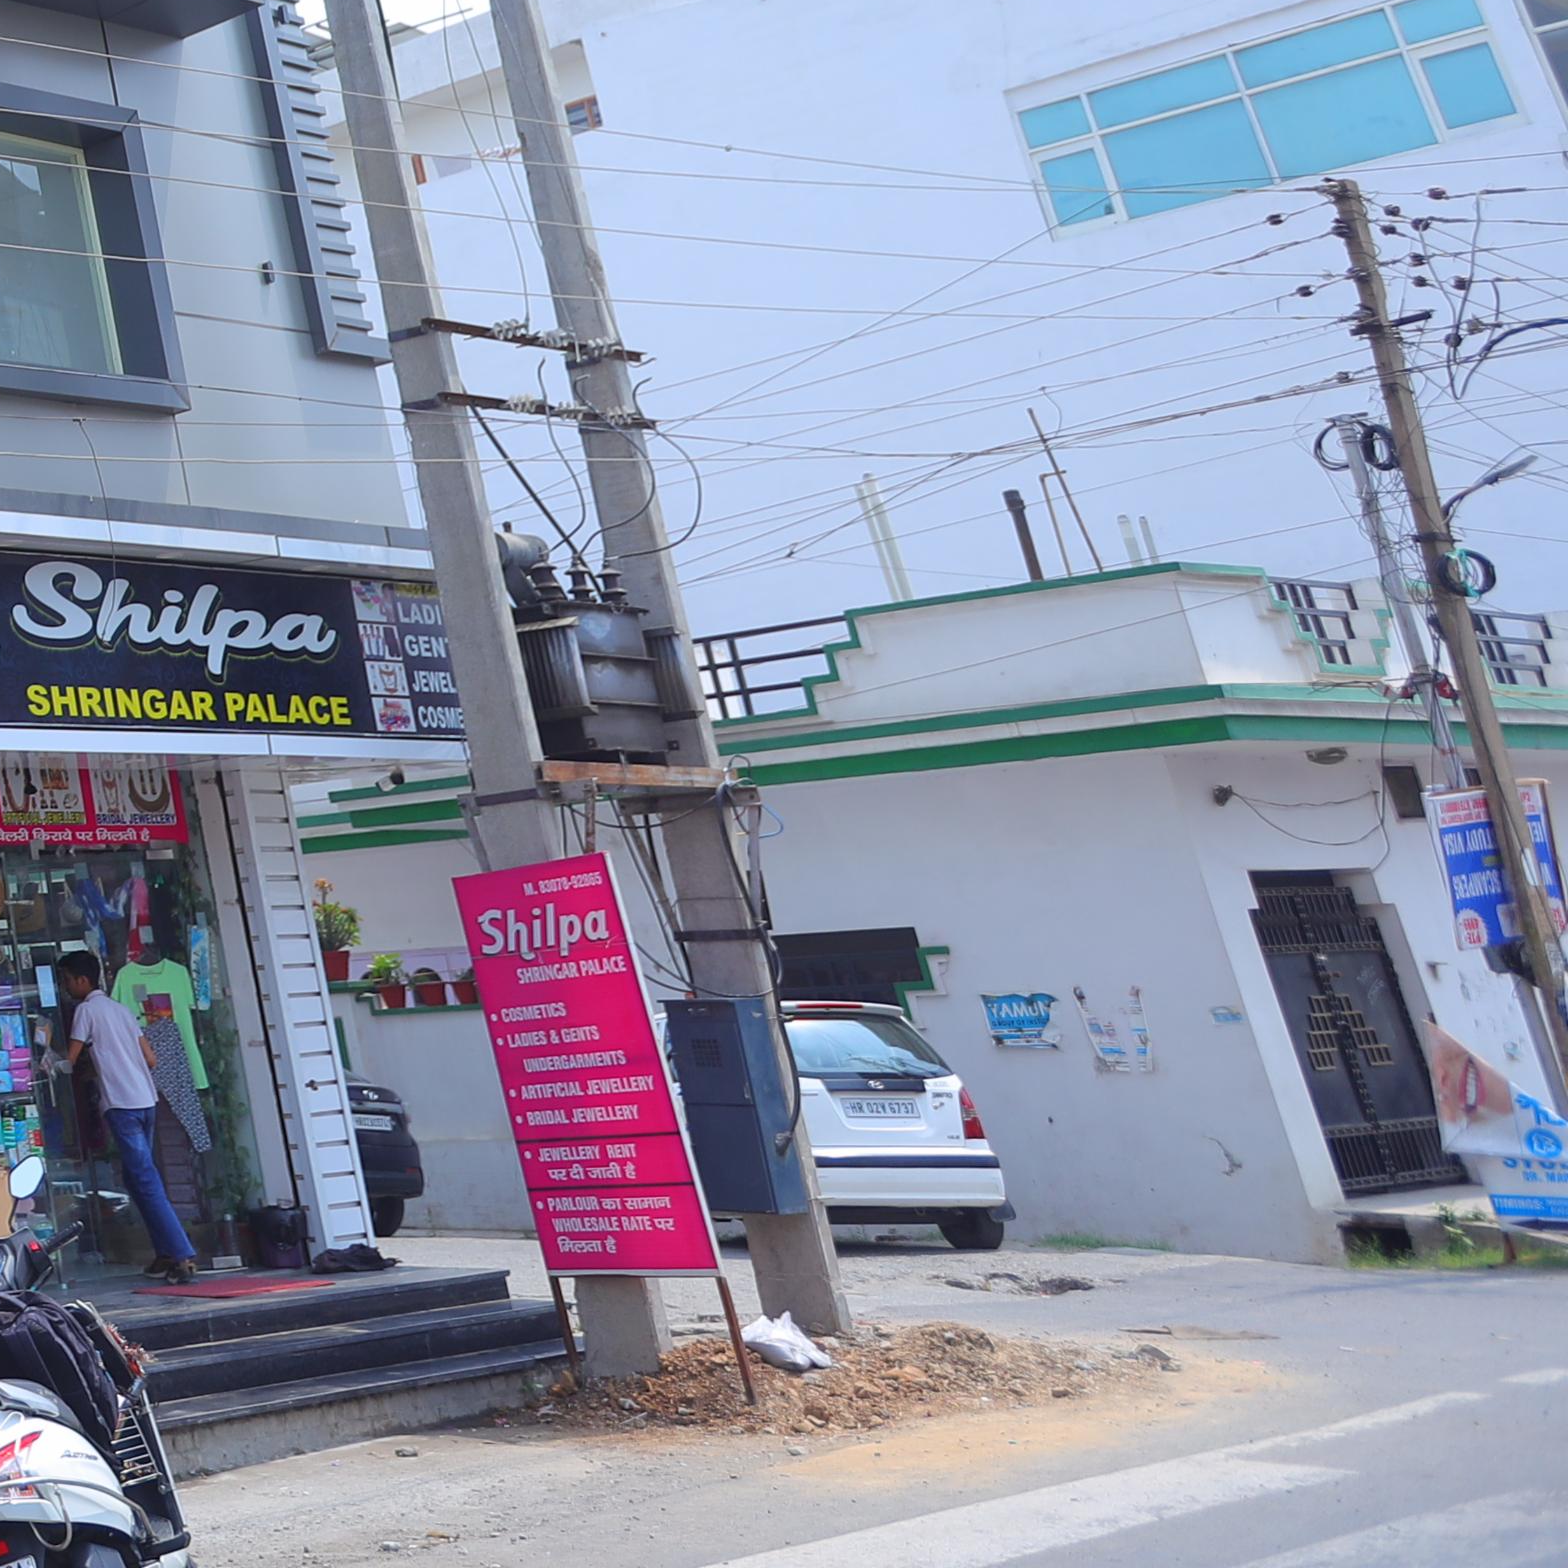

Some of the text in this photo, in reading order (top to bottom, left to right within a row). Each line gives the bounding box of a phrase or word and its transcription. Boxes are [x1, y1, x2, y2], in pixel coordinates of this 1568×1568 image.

[11, 560, 338, 678] Shilpa
[396, 601, 442, 626] LADI
[404, 634, 448, 658] GEN
[413, 670, 457, 694] JEWEL
[27, 683, 352, 726] SHRINGAR PALACE
[96, 813, 127, 825] BRIDAL
[76, 830, 94, 842] पर
[97, 827, 138, 842] मिलती
[138, 827, 152, 843] है
[477, 902, 610, 961] Shilpa
[516, 955, 627, 985] SHRINGAR PALACE
[500, 1001, 567, 1023] COSMETICS
[506, 1025, 601, 1048] LADIES & GENTS
[523, 1049, 627, 1074] UNDERGARMENTS
[521, 1075, 655, 1101] ARTIFICIAL JEWELLERY
[526, 1104, 640, 1126] BRIDAL JEWELLERY
[849, 1101, 864, 1114] HR
[888, 1102, 915, 1114] 6737
[537, 1143, 637, 1163] JEWELLERY RENT
[547, 1160, 637, 1181] पर दी जाती है
[547, 1196, 672, 1212] PARLOUR का सामान
[551, 1216, 676, 1234] WHOLESALE RATE पर
[556, 1235, 617, 1254] मिलता है
